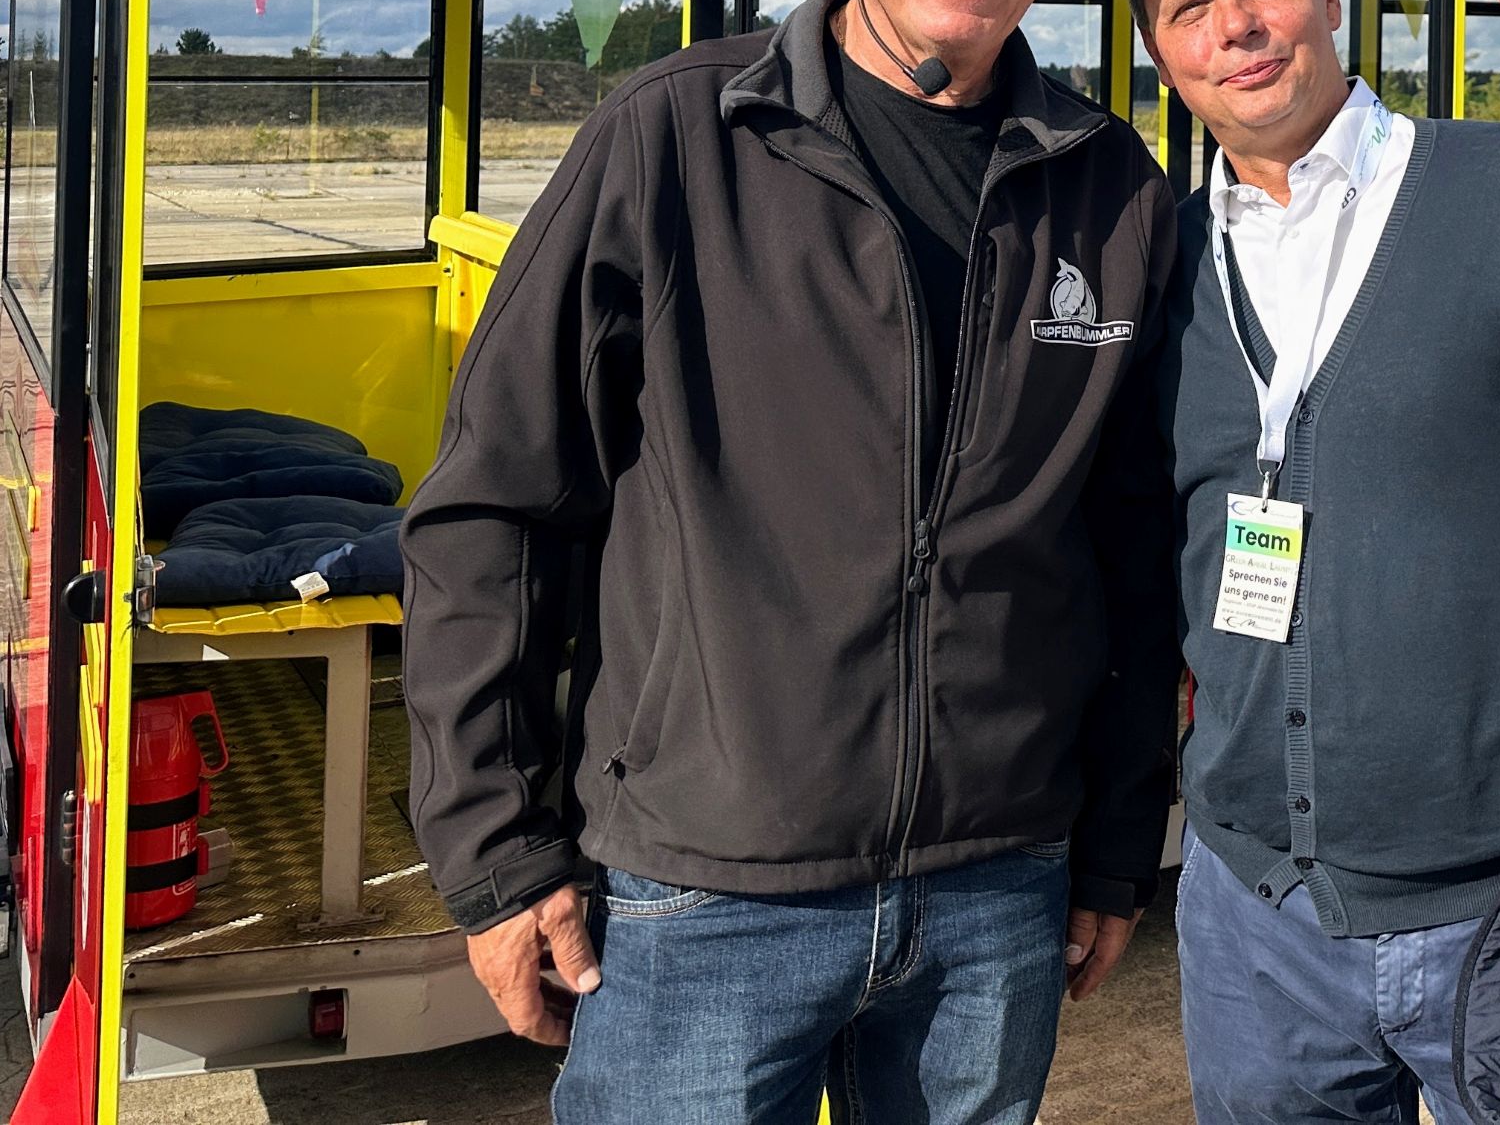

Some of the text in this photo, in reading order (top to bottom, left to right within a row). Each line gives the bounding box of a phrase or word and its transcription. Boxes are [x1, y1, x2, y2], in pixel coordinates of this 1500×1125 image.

[1234, 525, 1290, 552] Team
[1229, 568, 1288, 588] Sprechen Sie
[1224, 586, 1287, 605] uns gerne an!
